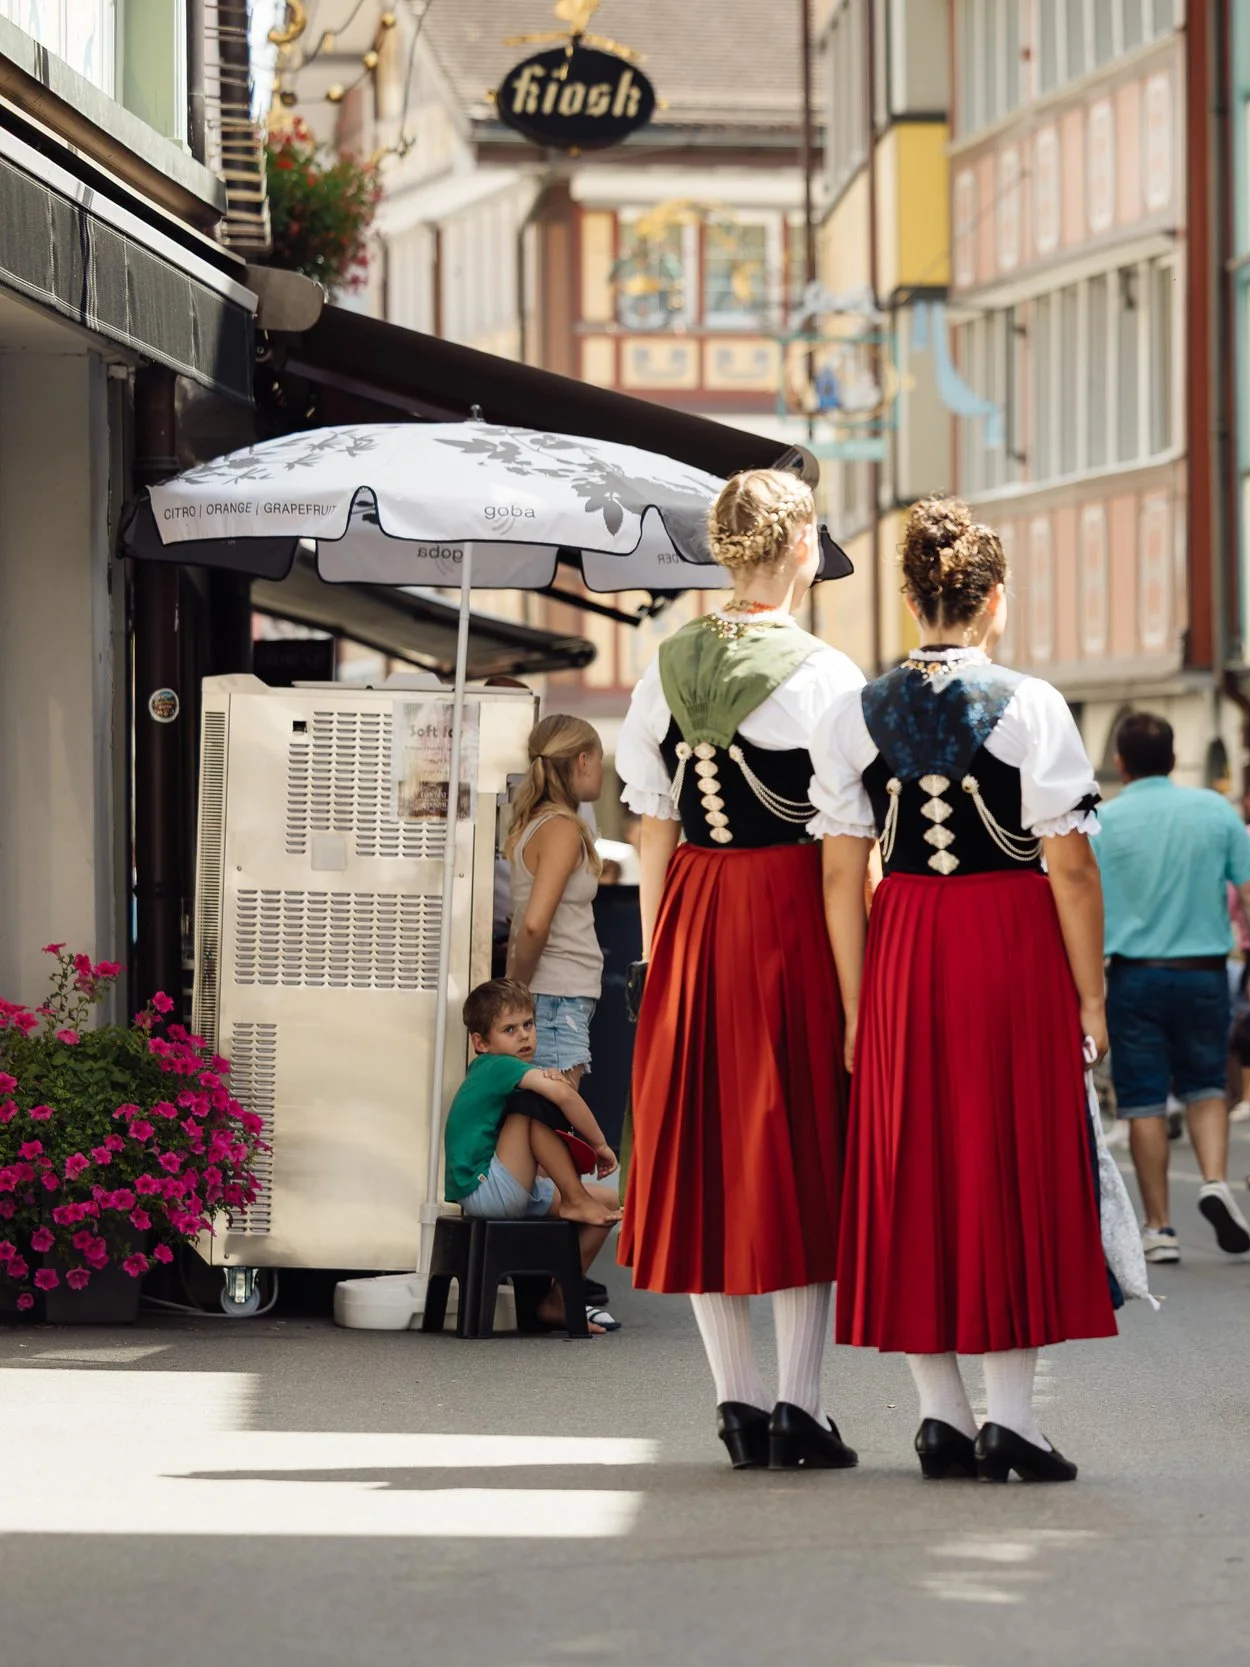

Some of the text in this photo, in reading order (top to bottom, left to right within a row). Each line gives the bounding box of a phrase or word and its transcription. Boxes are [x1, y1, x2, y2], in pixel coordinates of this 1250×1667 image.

[513, 64, 641, 118] Kiosk
[164, 506, 195, 520] CITRO
[206, 503, 252, 515] ORANGE
[263, 502, 337, 516] GRAPEFRUIT
[484, 505, 535, 519] goba
[410, 724, 438, 737] Soft
